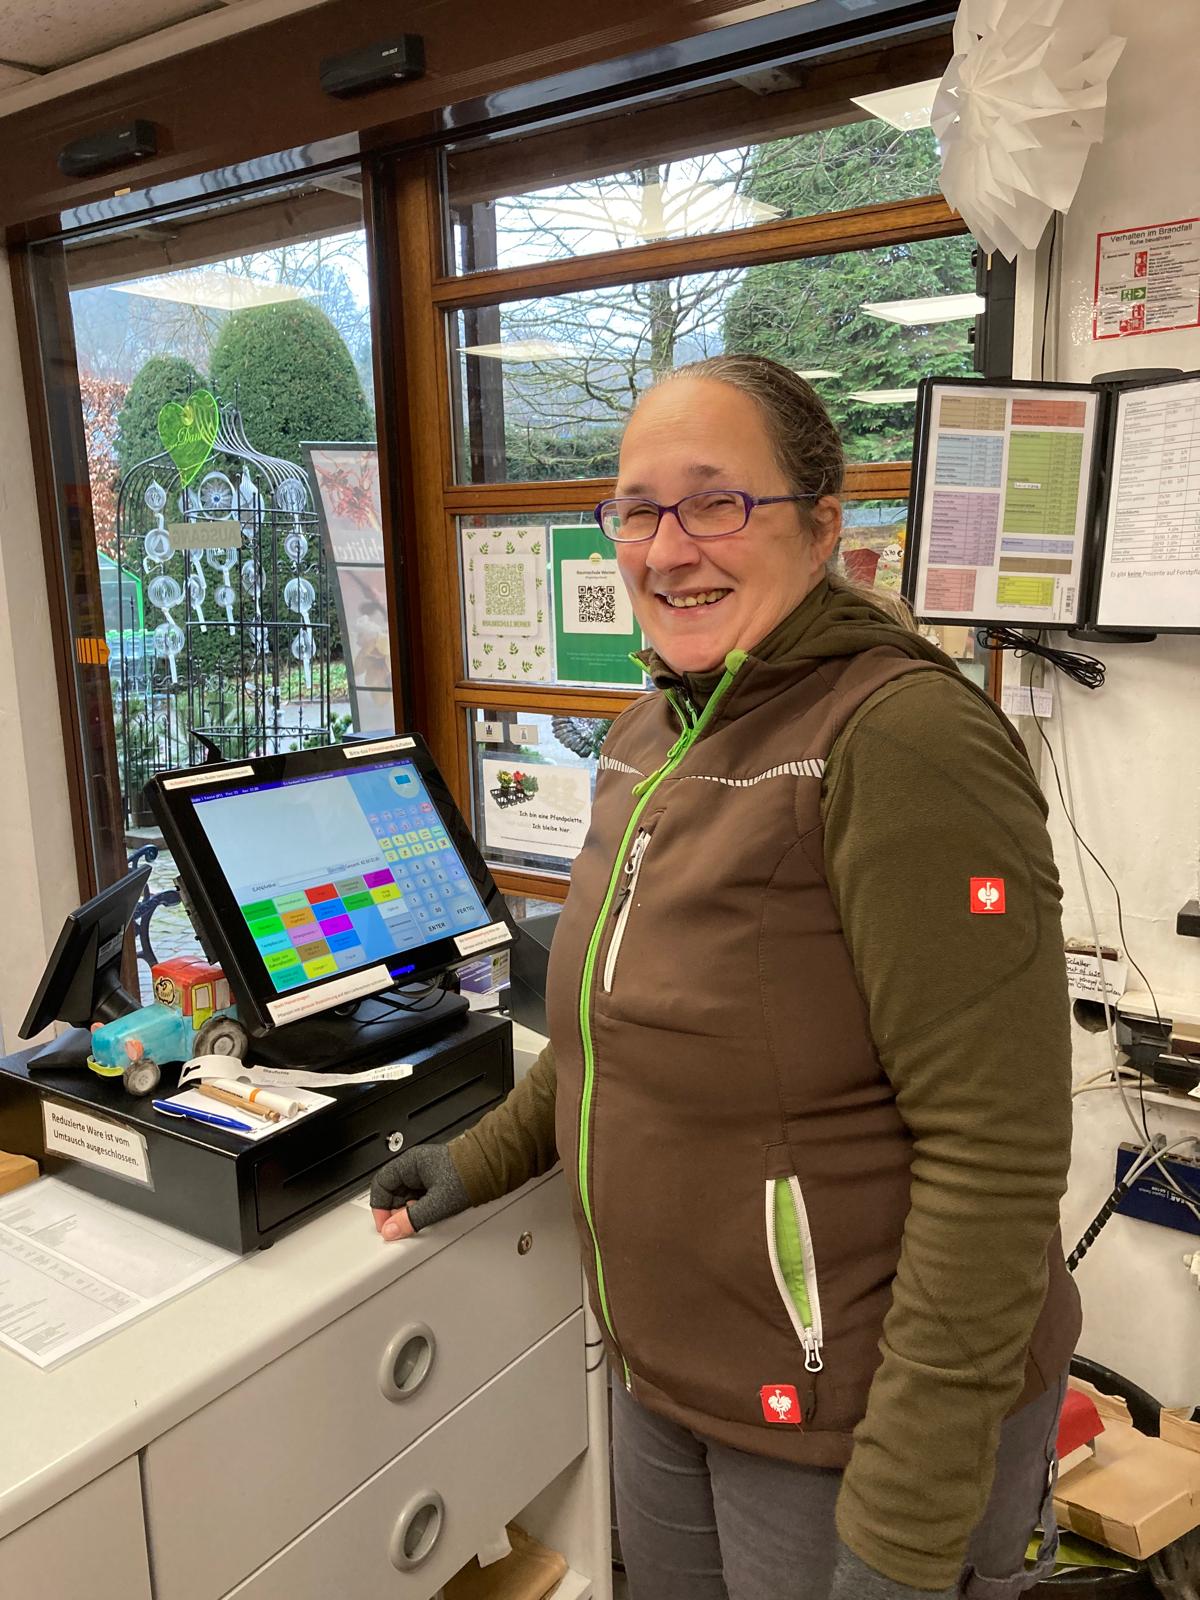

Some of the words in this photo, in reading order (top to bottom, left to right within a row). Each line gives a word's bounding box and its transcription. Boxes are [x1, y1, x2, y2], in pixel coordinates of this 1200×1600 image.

[1110, 231, 1146, 242] Verhalten
[1147, 229, 1156, 237] im
[1158, 224, 1192, 235] Brandfall
[1128, 570, 1142, 578] keine
[456, 905, 475, 915] FERTIG
[428, 922, 446, 932] ENTER
[52, 1112, 86, 1132] Reduzierte
[86, 1124, 104, 1139] Ware
[104, 1131, 114, 1142] ist
[115, 1137, 130, 1148] vom
[54, 1130, 86, 1148] Umtausch
[86, 1142, 140, 1166] ausgeschlossen.
